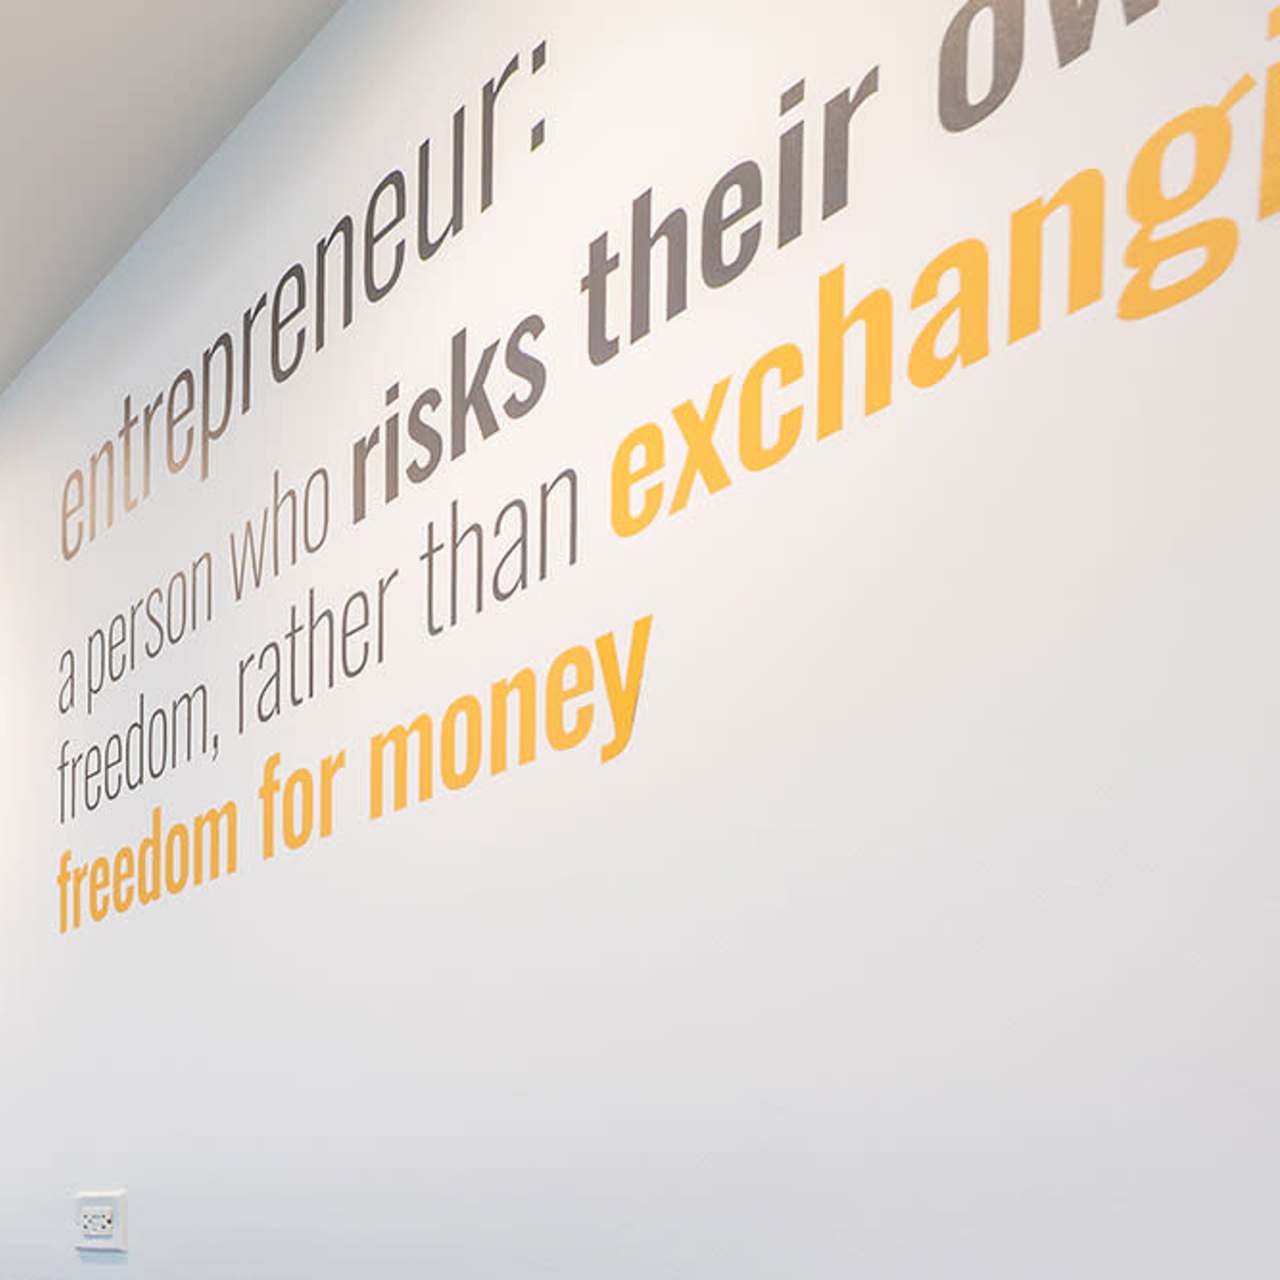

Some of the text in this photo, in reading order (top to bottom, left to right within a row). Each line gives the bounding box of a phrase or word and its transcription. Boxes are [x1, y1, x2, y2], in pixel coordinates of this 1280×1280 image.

[57, 649, 76, 716] a
[87, 552, 213, 715] person
[229, 467, 330, 602] who
[351, 313, 548, 526] risks
[579, 66, 881, 368] their
[60, 39, 548, 562] entrepreneur:
[56, 683, 220, 827] freedom,
[237, 568, 400, 735] rather
[418, 468, 579, 637] than
[56, 613, 655, 936] freedom for money
